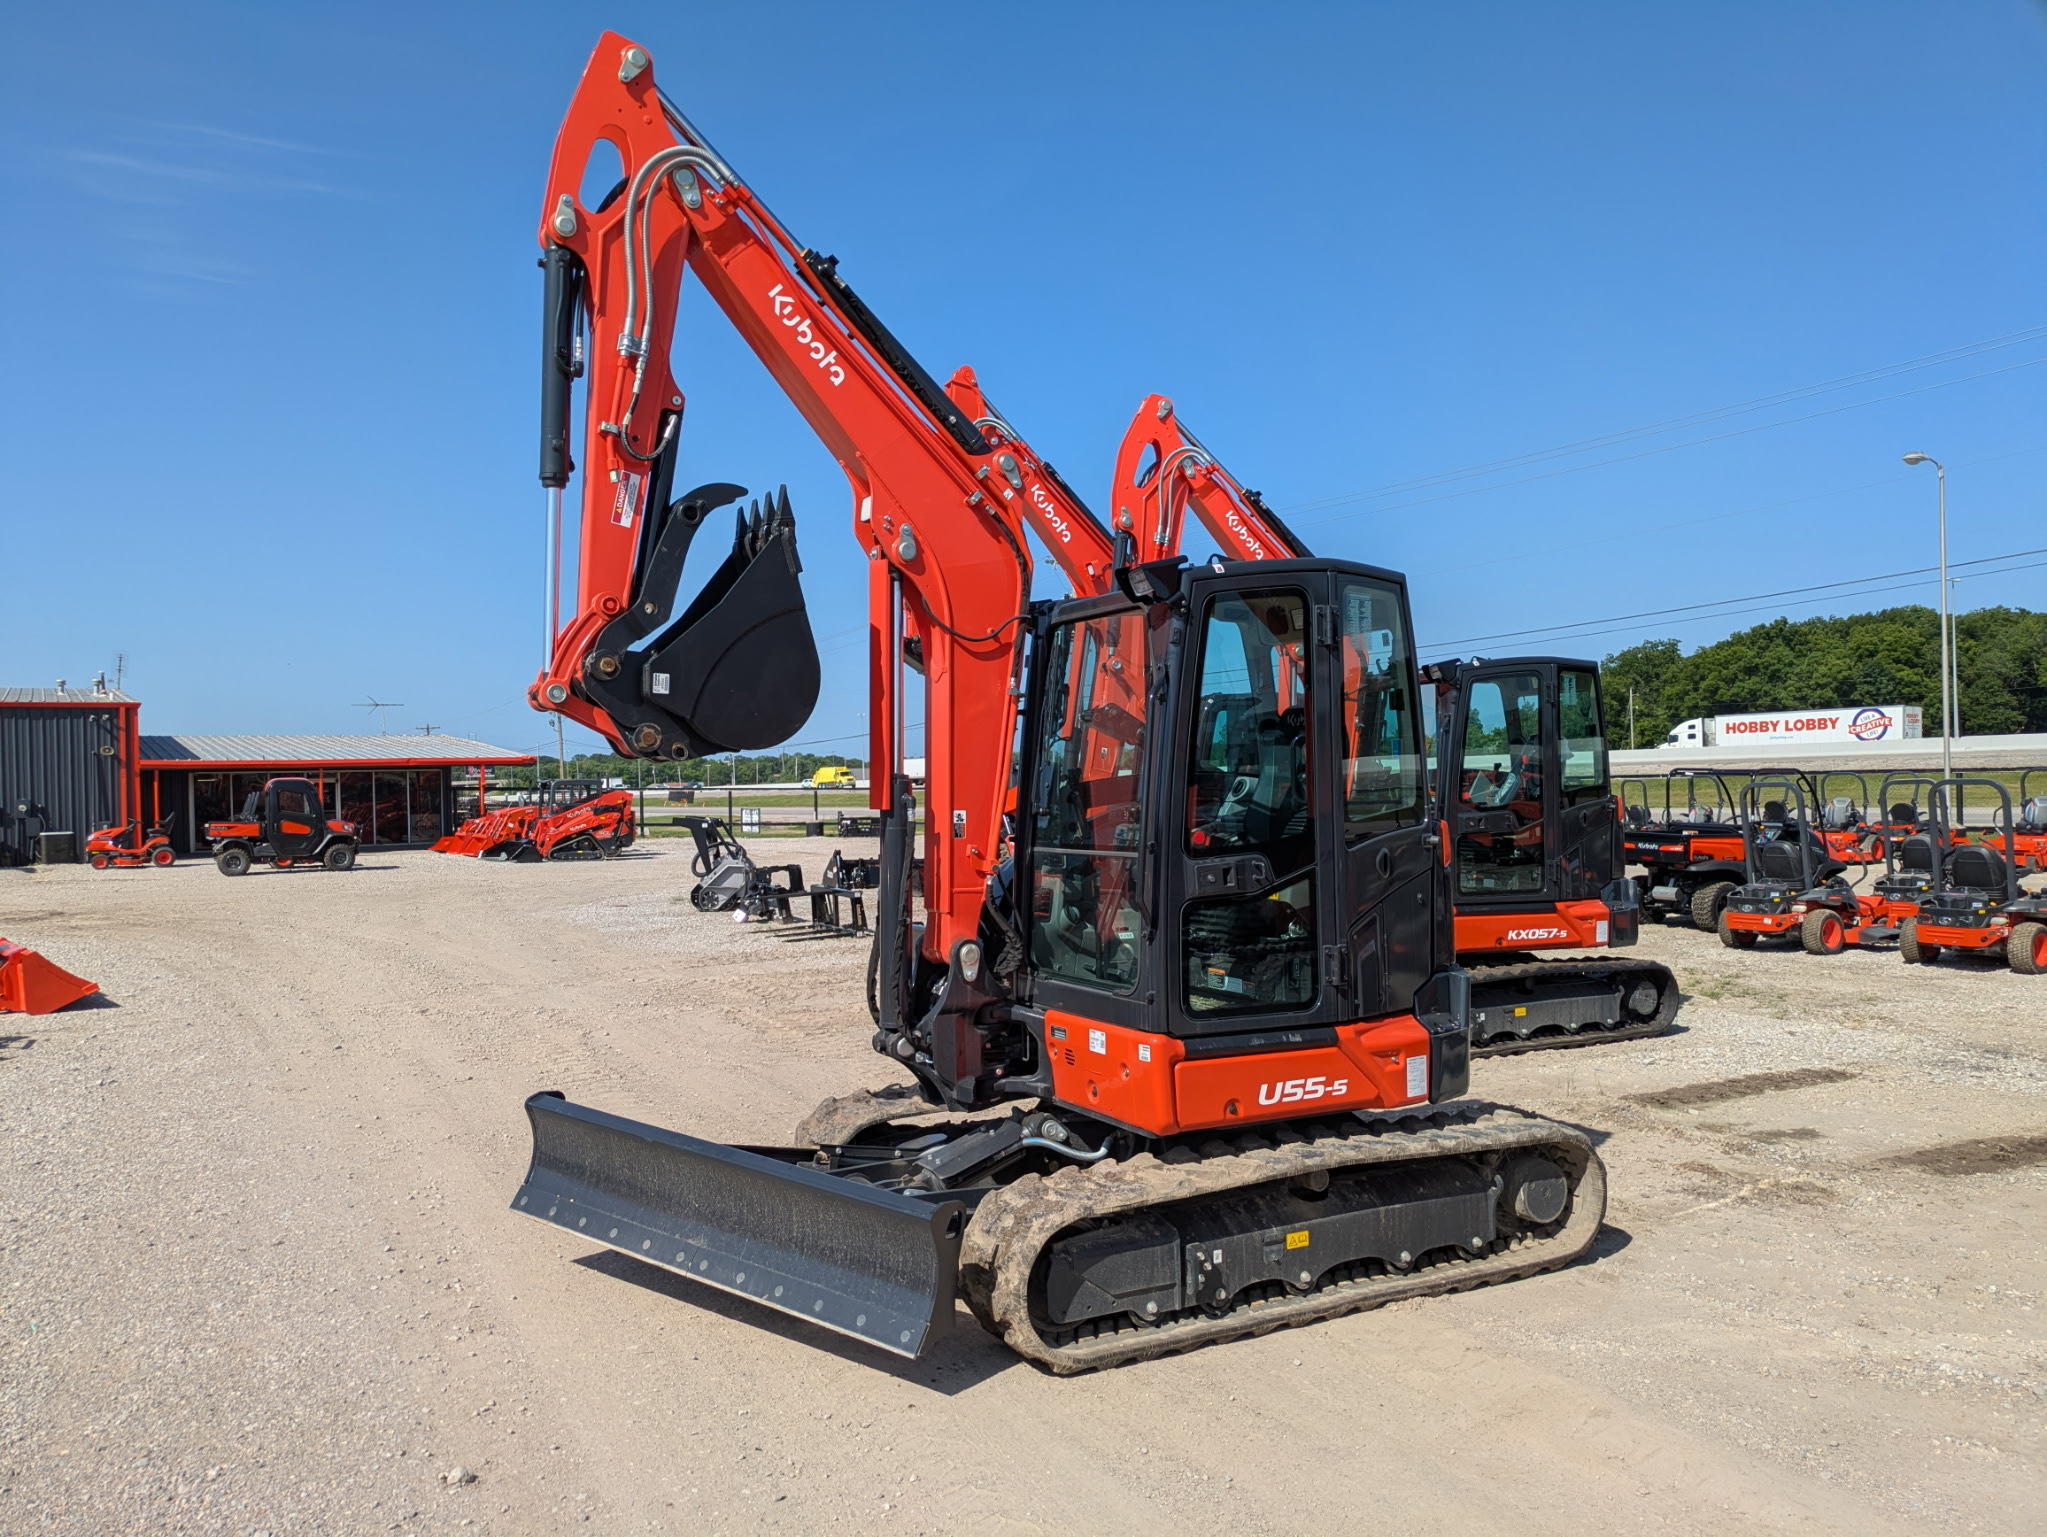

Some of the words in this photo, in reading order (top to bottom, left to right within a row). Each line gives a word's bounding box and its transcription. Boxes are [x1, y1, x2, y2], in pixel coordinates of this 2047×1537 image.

[768, 283, 845, 387] Kubota
[616, 480, 628, 508] DANGER
[1030, 483, 1071, 544] Kubota
[1225, 509, 1264, 560] Kubota
[1725, 720, 1780, 734] HOBBY
[1785, 717, 1840, 732] LOBBY
[1850, 718, 1891, 734] CREATIVE
[566, 806, 592, 819] Kubota
[1637, 842, 1659, 850] Kubota
